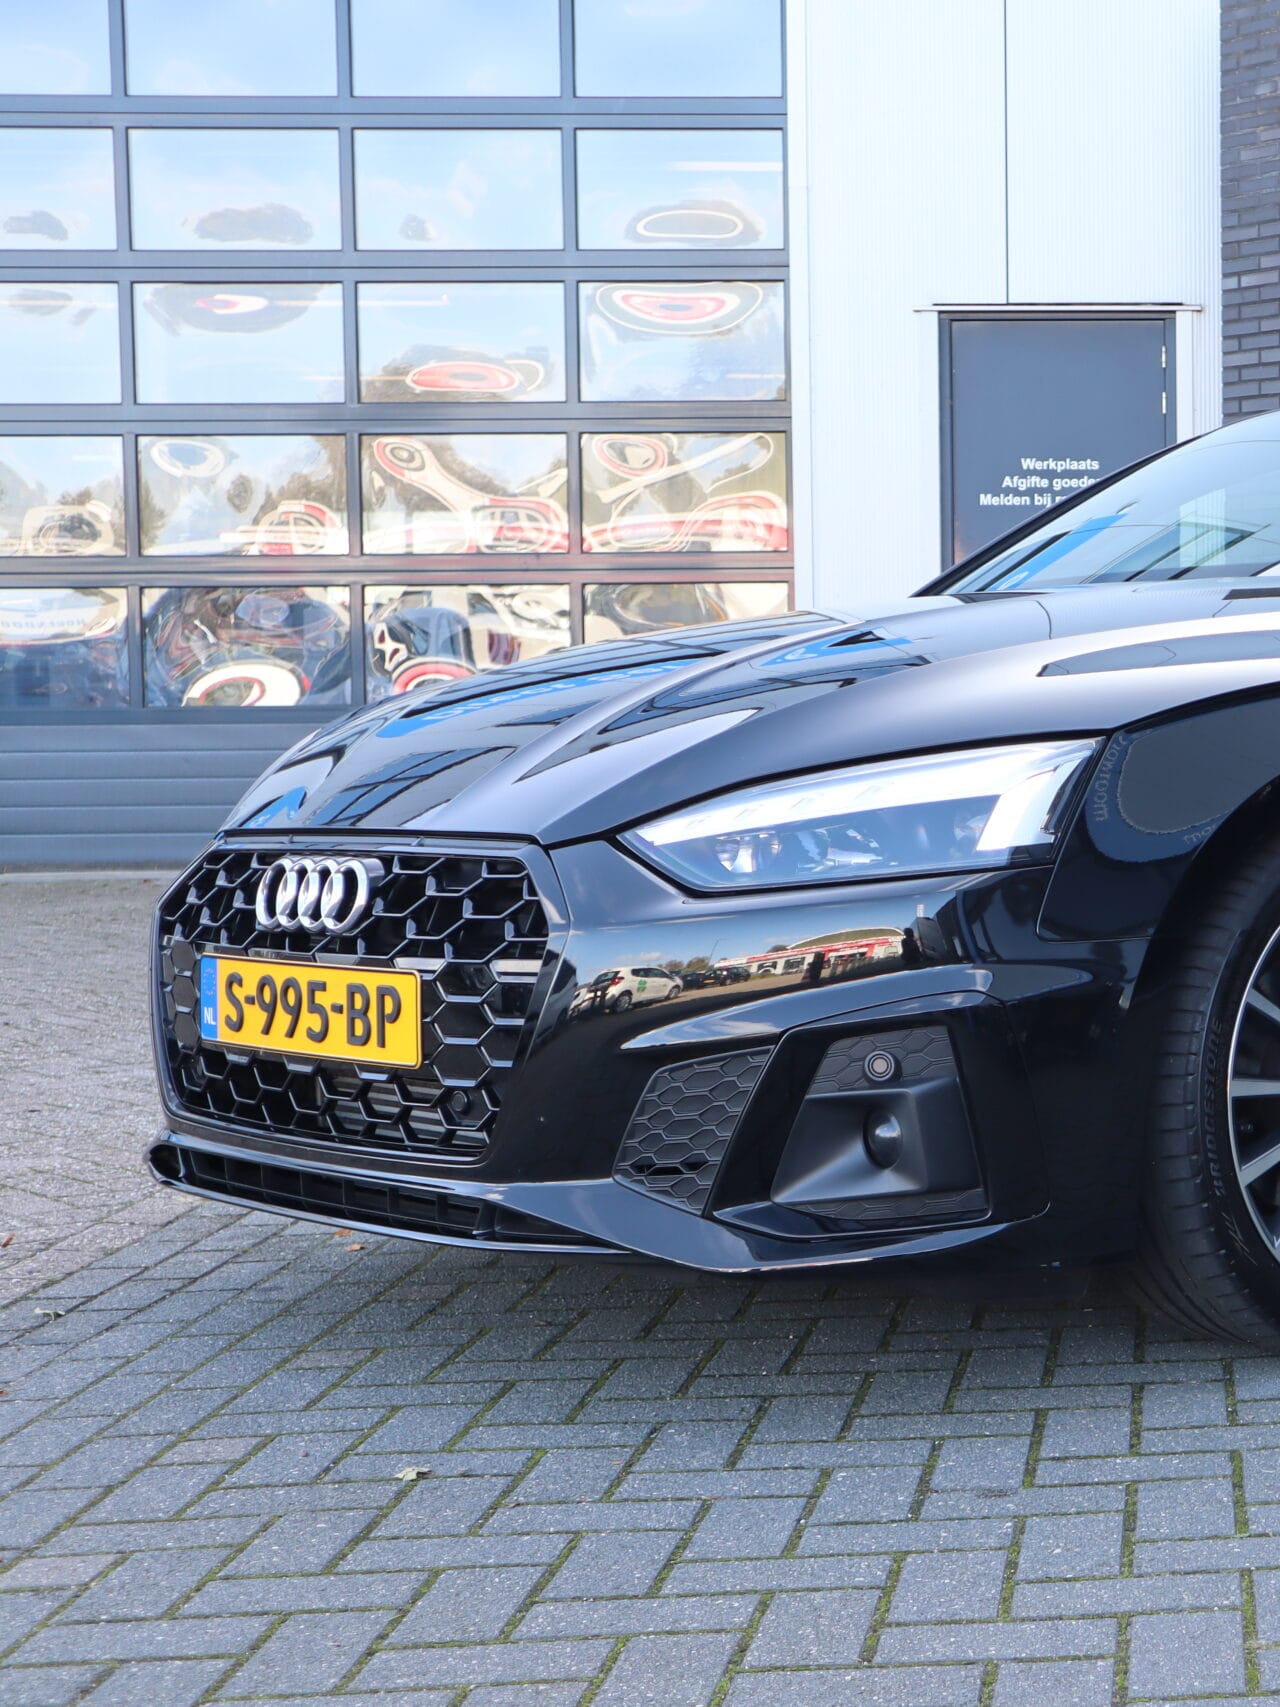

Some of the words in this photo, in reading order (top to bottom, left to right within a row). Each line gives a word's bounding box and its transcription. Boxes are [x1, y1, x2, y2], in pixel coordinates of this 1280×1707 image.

[1021, 458, 1100, 472] Werkplaats
[1002, 476, 1049, 490] Afgifte
[979, 494, 1030, 505] Melden
[1034, 494, 1052, 507] bij
[204, 1007, 216, 1025] NL
[224, 972, 402, 1048] S-995-BP
